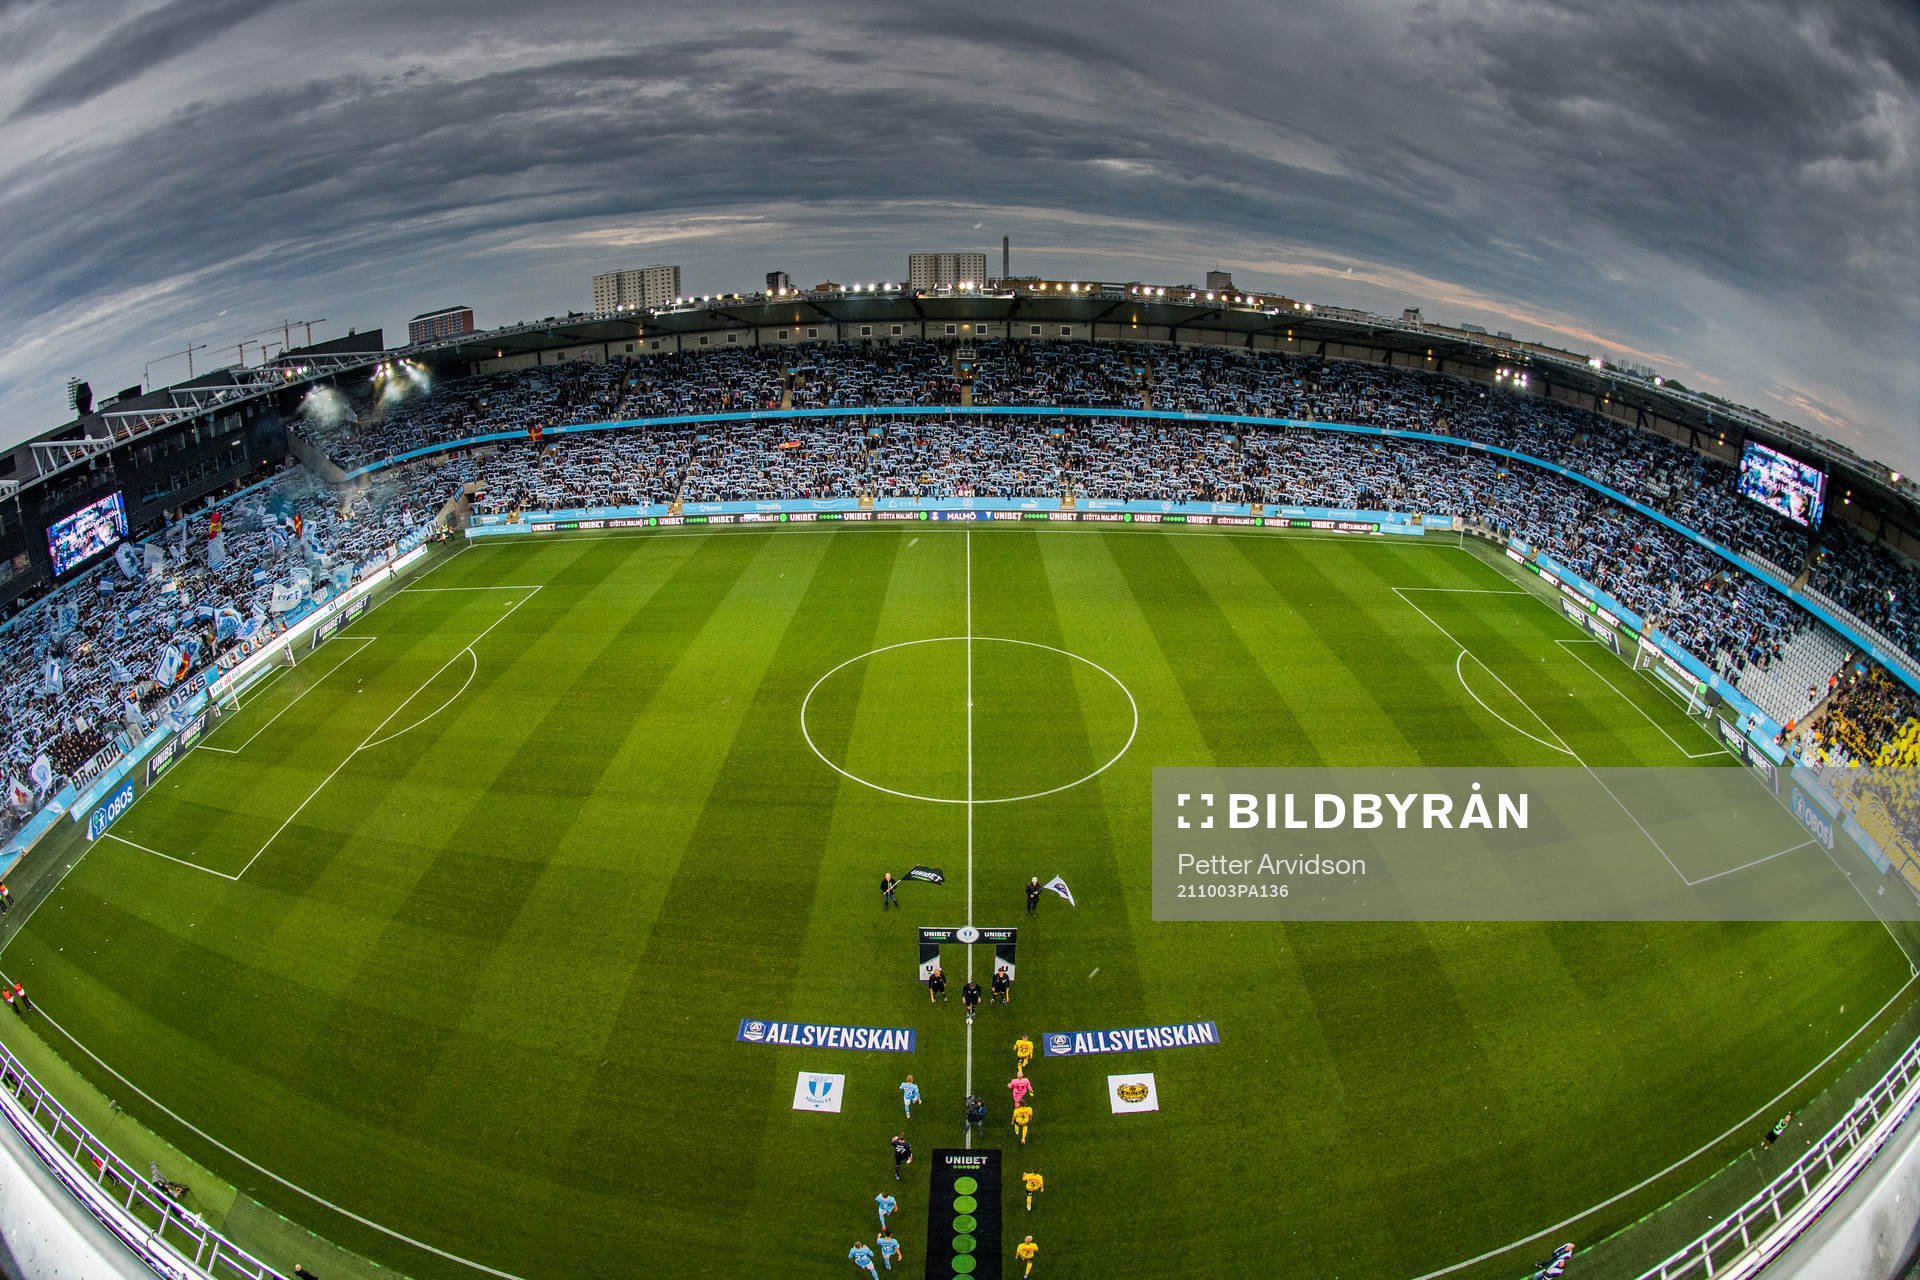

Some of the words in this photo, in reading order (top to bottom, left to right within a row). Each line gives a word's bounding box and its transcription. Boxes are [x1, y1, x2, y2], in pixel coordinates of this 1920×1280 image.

[708, 515, 735, 524] UNIBET
[789, 513, 818, 522] UNIBET
[843, 512, 872, 521] UNIBET
[947, 511, 977, 520] MALMÖ
[993, 512, 1022, 521] UNIBET
[1049, 512, 1078, 521] UNIBET
[1134, 514, 1162, 523] UNIBET
[1186, 515, 1213, 524] UNIBET
[578, 520, 604, 530] UNIBET
[658, 516, 685, 526] UNIBET
[1264, 517, 1290, 527] UNIBET
[1311, 520, 1336, 530] UNIBET
[532, 523, 556, 532] UNIBET
[345, 595, 369, 618] UNIBET
[318, 612, 343, 637] UNIBET
[181, 713, 207, 744] UNIBET
[152, 738, 179, 772] UNIBET
[107, 785, 134, 822] OBOS
[1804, 806, 1830, 845] OBOS
[910, 868, 943, 883] UNIBET
[923, 930, 952, 938] UNIBET
[926, 965, 933, 973] U
[765, 1022, 910, 1051] ALLSVENSKAN
[1074, 1022, 1214, 1054] ALLSVENSKAN
[945, 1156, 988, 1165] UNIBET
